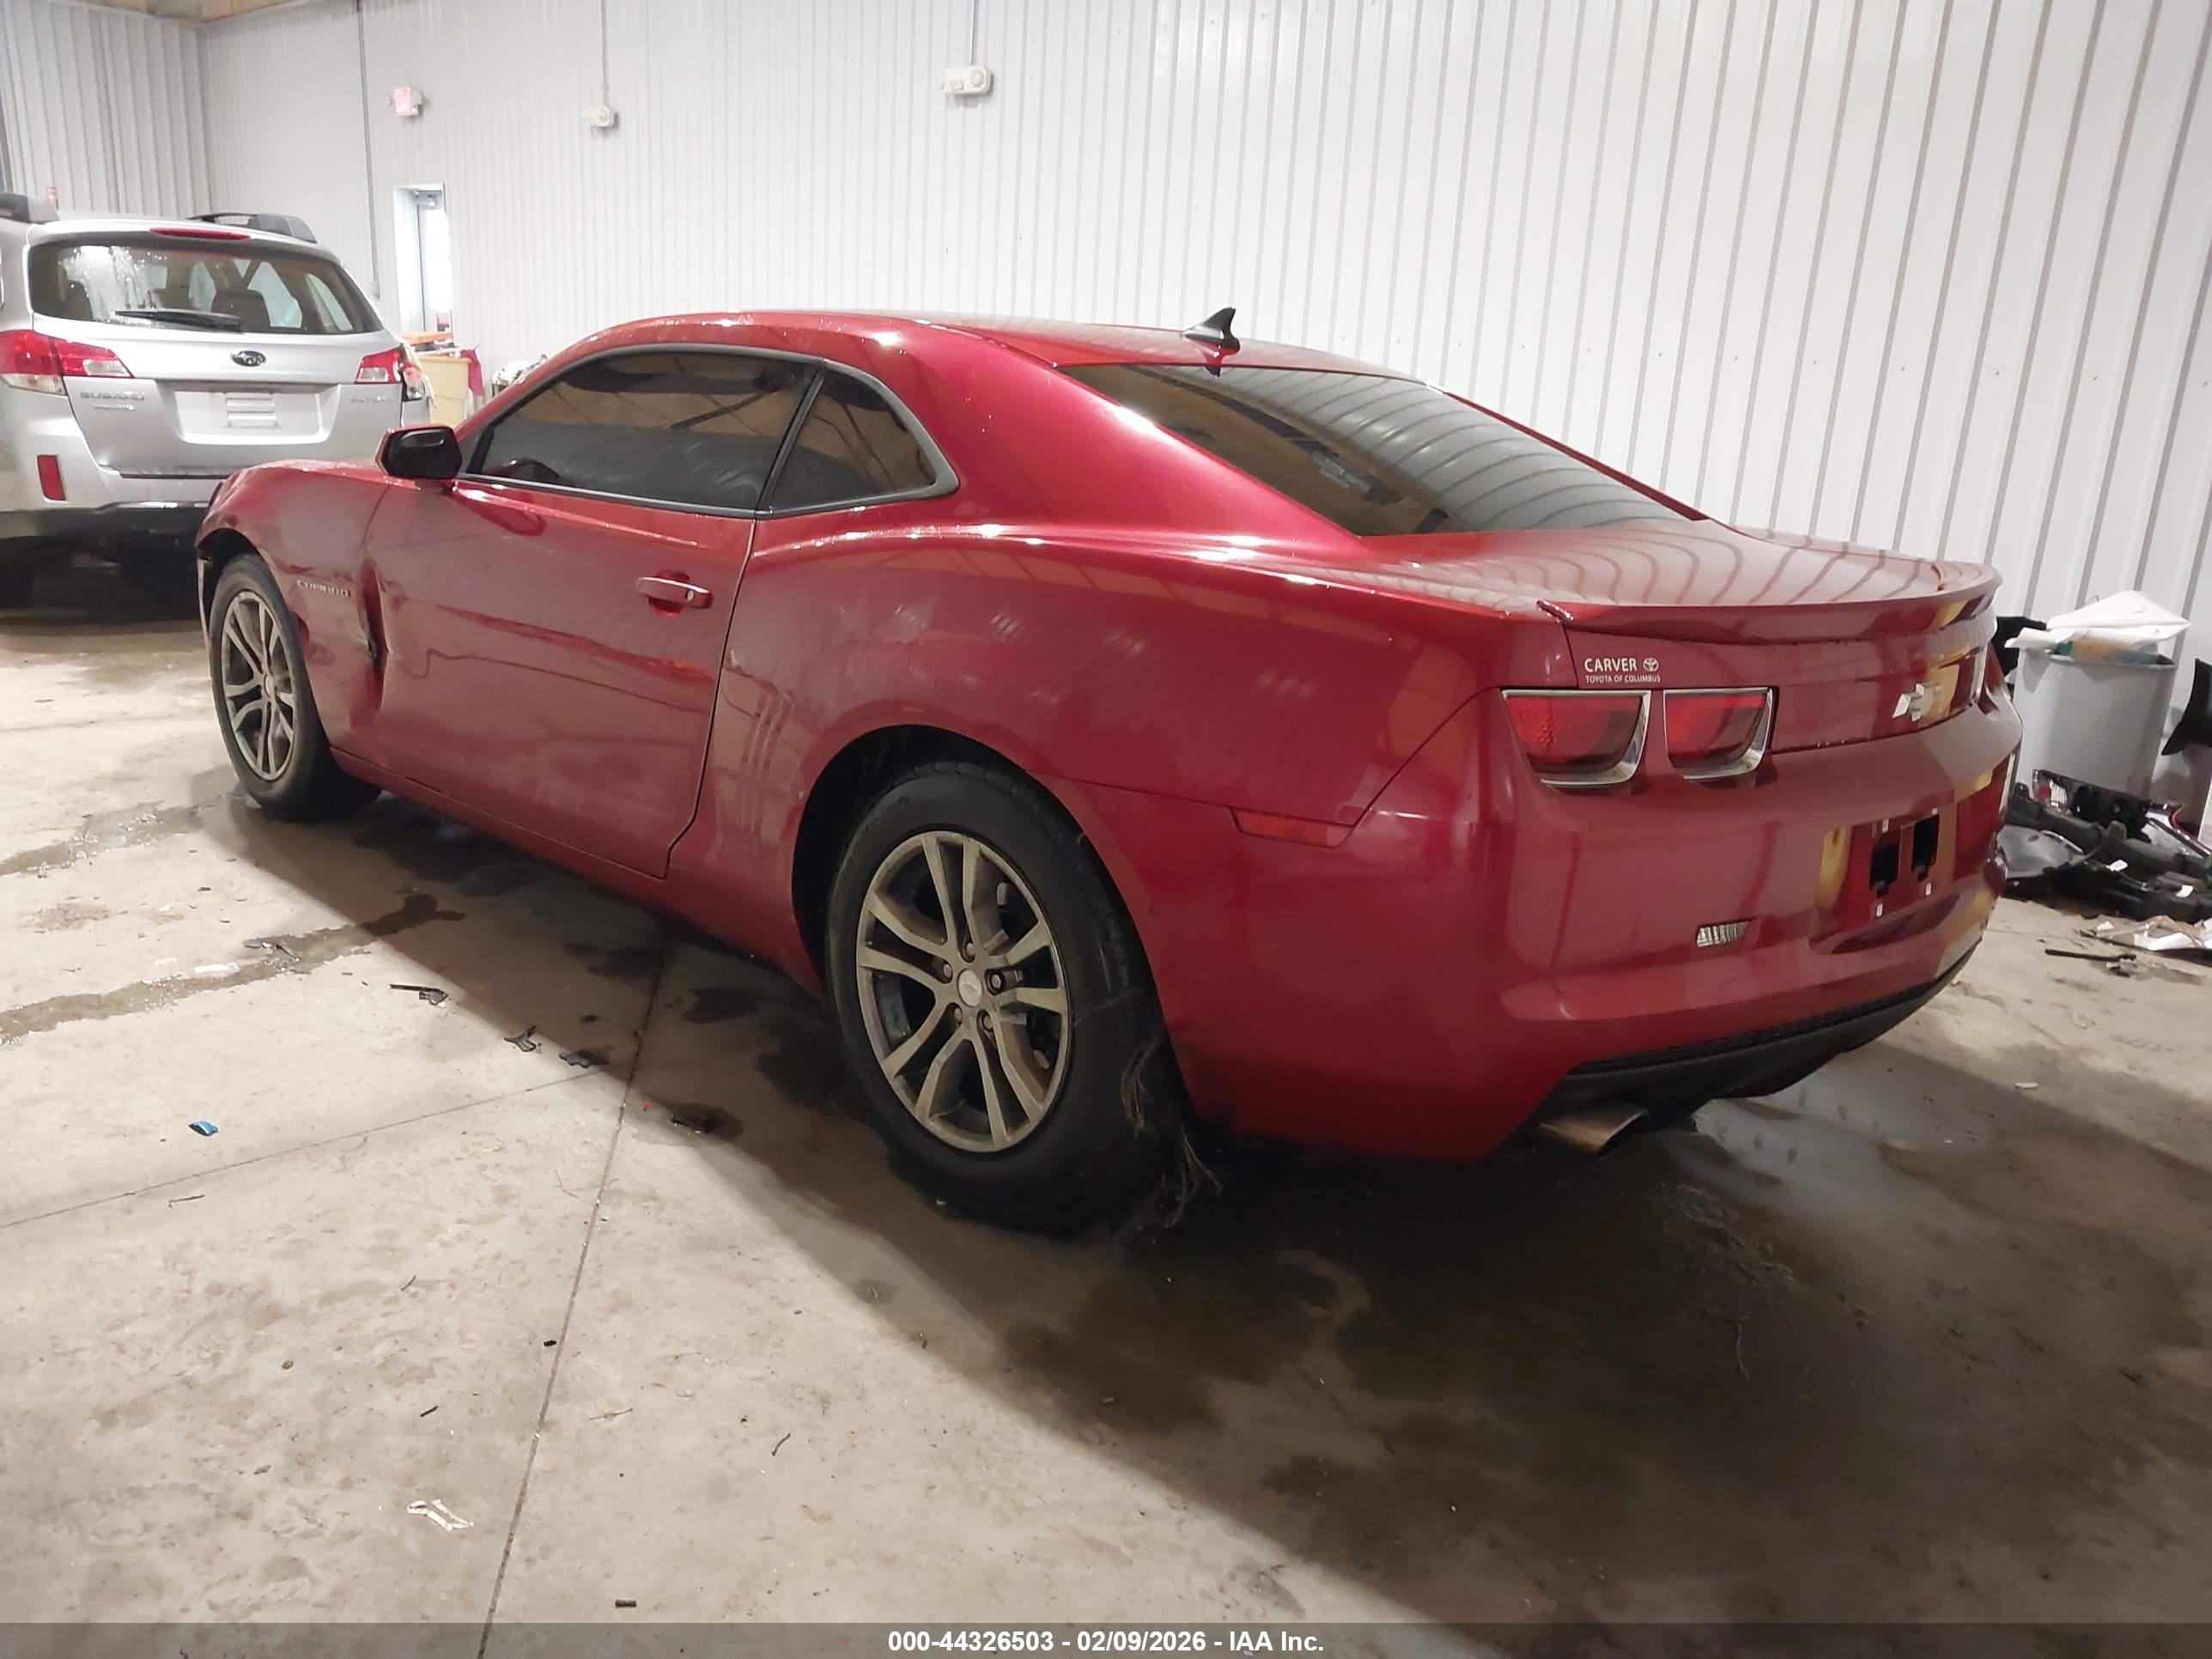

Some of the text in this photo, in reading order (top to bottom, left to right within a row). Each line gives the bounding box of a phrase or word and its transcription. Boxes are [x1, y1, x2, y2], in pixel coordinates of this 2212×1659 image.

[1584, 658, 1638, 672] CARVER
[1585, 674, 1661, 684] TOYOTA OF COLUMBUS
